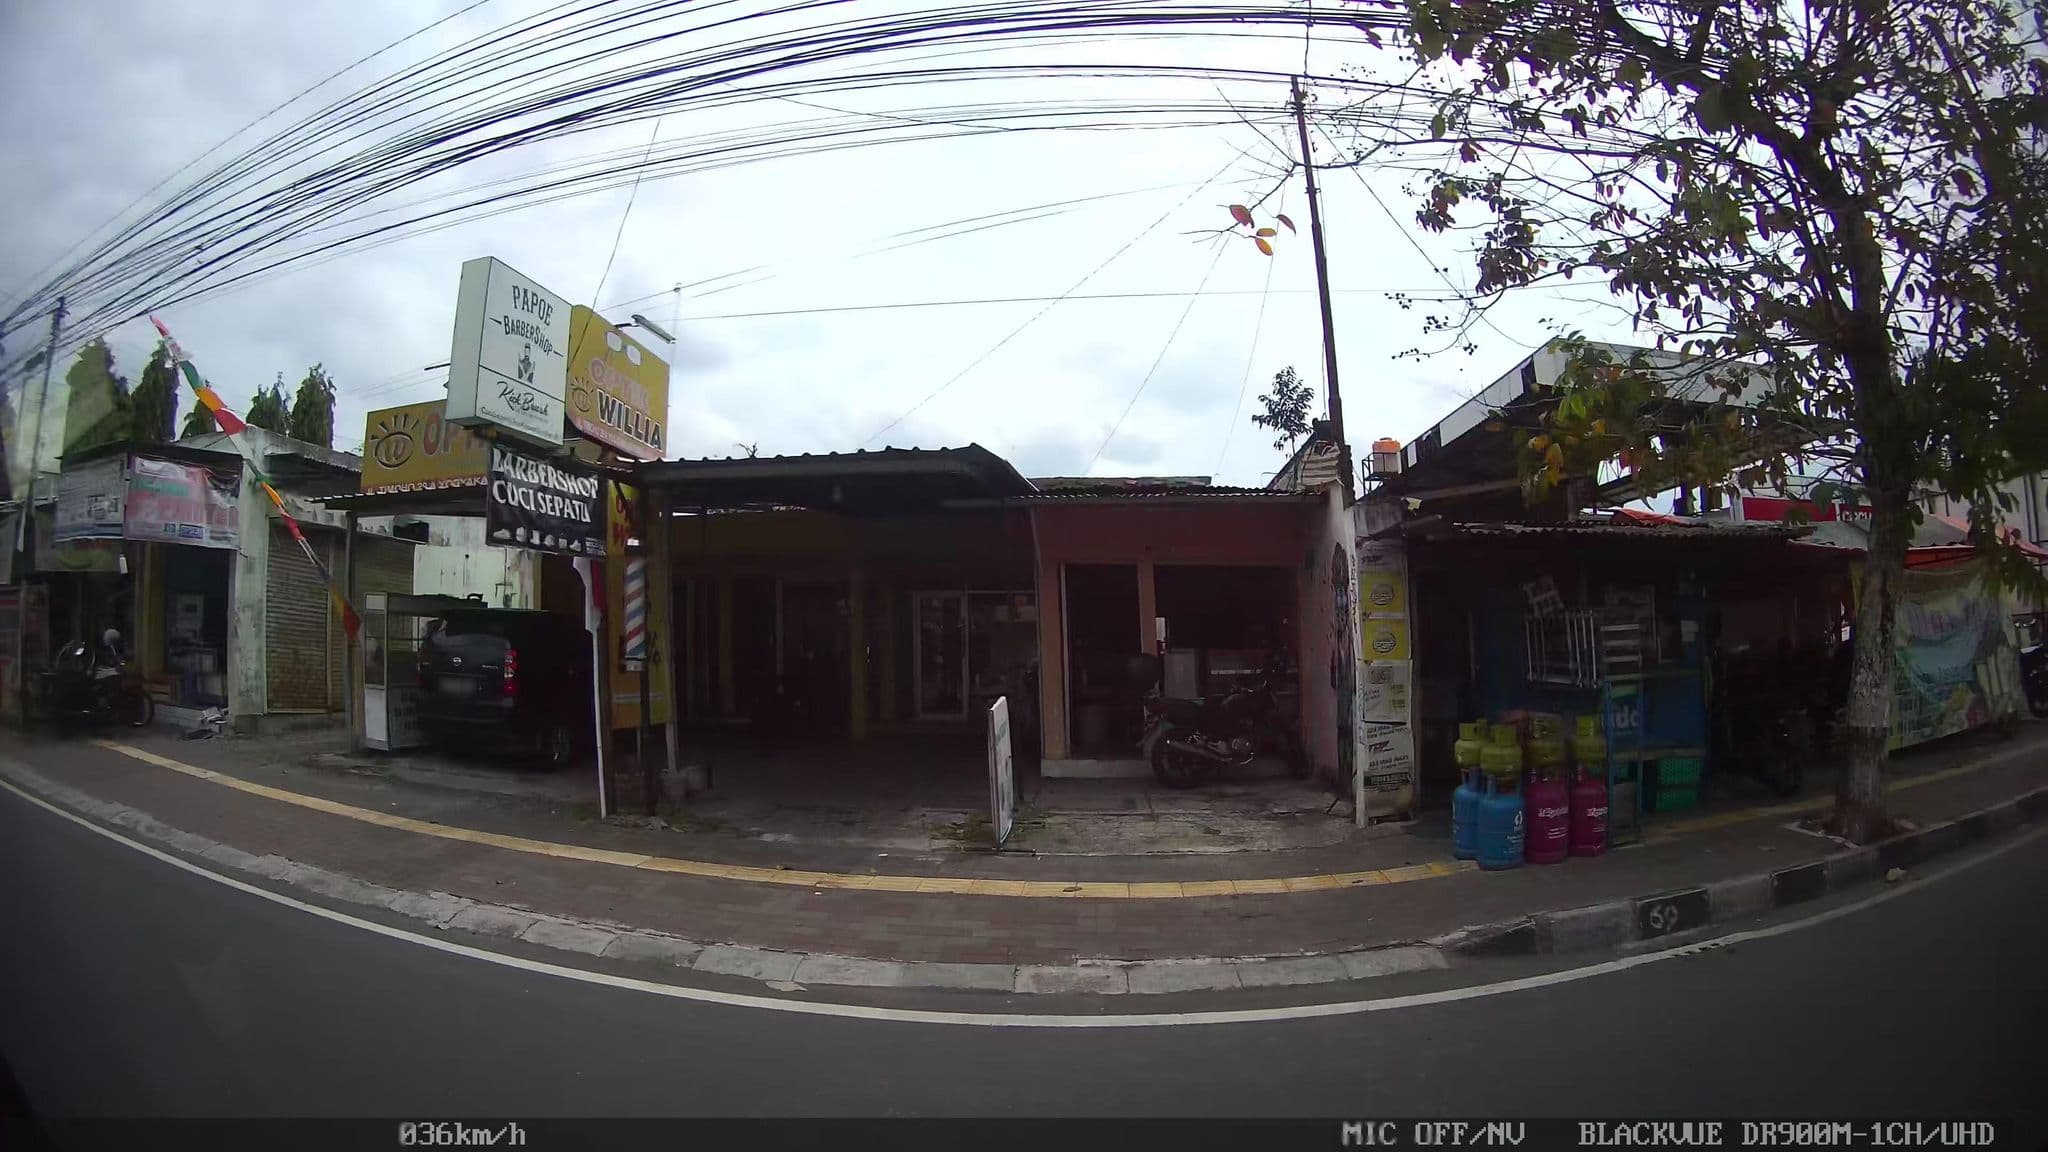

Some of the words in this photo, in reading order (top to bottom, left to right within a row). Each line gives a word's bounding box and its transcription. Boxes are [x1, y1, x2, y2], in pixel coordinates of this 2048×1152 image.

[511, 284, 554, 327] PAPOE
[596, 387, 663, 453] WILLIA
[491, 479, 537, 511] CUCI
[537, 490, 592, 523] SEPATU
